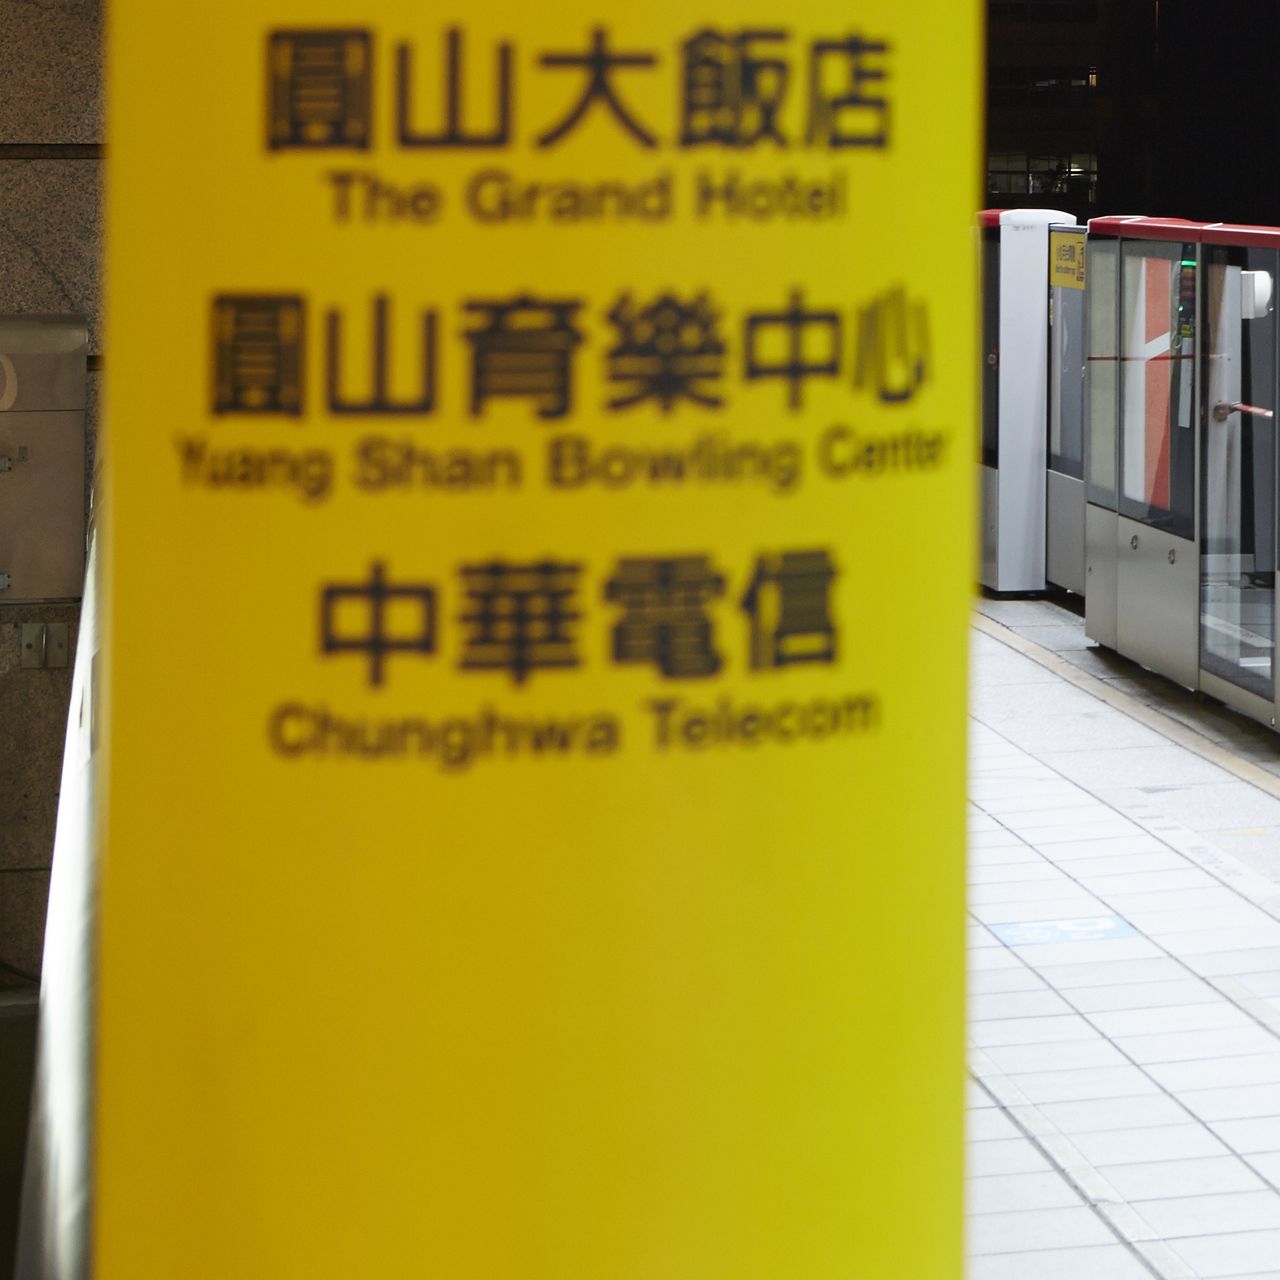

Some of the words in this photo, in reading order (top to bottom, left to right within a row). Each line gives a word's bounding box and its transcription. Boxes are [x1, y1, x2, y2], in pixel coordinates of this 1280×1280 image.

[264, 26, 892, 155] 圓山大飯店
[326, 170, 439, 224] The
[464, 171, 673, 224] Grand
[694, 169, 847, 222] Hotel
[174, 434, 331, 506] Yuang
[350, 434, 523, 492] Shan
[547, 433, 801, 497] Bowling
[316, 546, 839, 690] 中華電信
[266, 702, 622, 774] Chunghwa
[648, 692, 880, 752] Telecom
